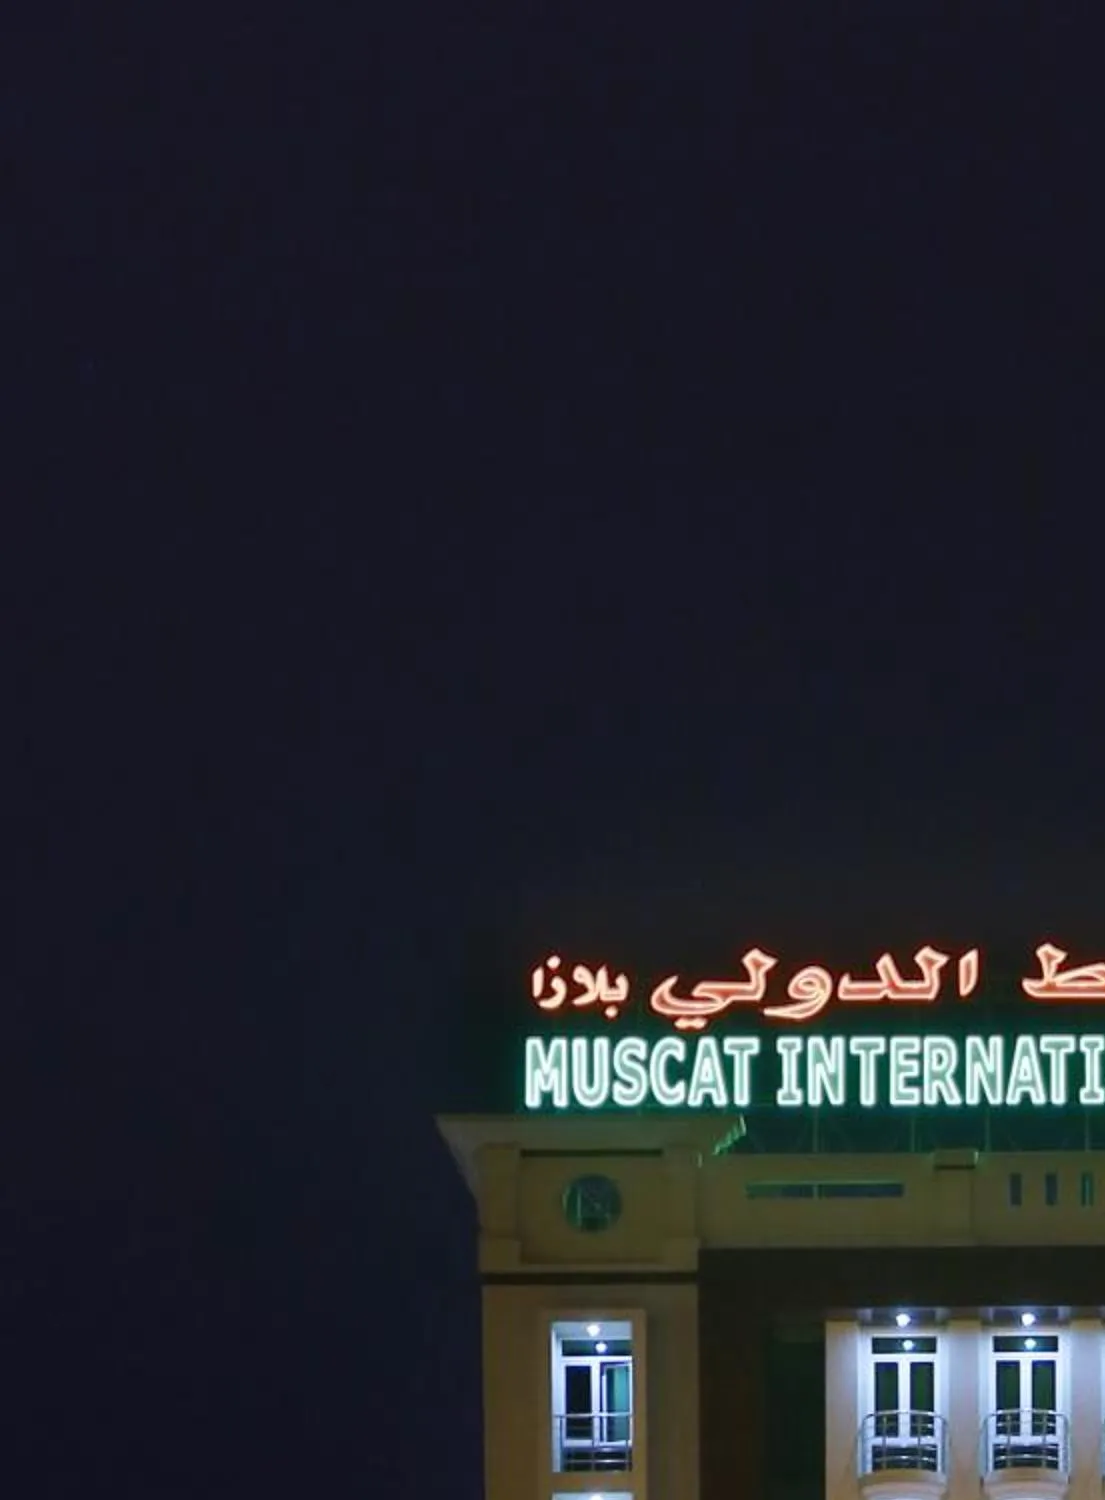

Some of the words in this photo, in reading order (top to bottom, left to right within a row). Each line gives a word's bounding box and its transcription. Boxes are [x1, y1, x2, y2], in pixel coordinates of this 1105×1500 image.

[531, 955, 629, 1019] بلازا
[650, 946, 980, 1029] الدولي
[525, 1036, 760, 1108] MUSCAT
